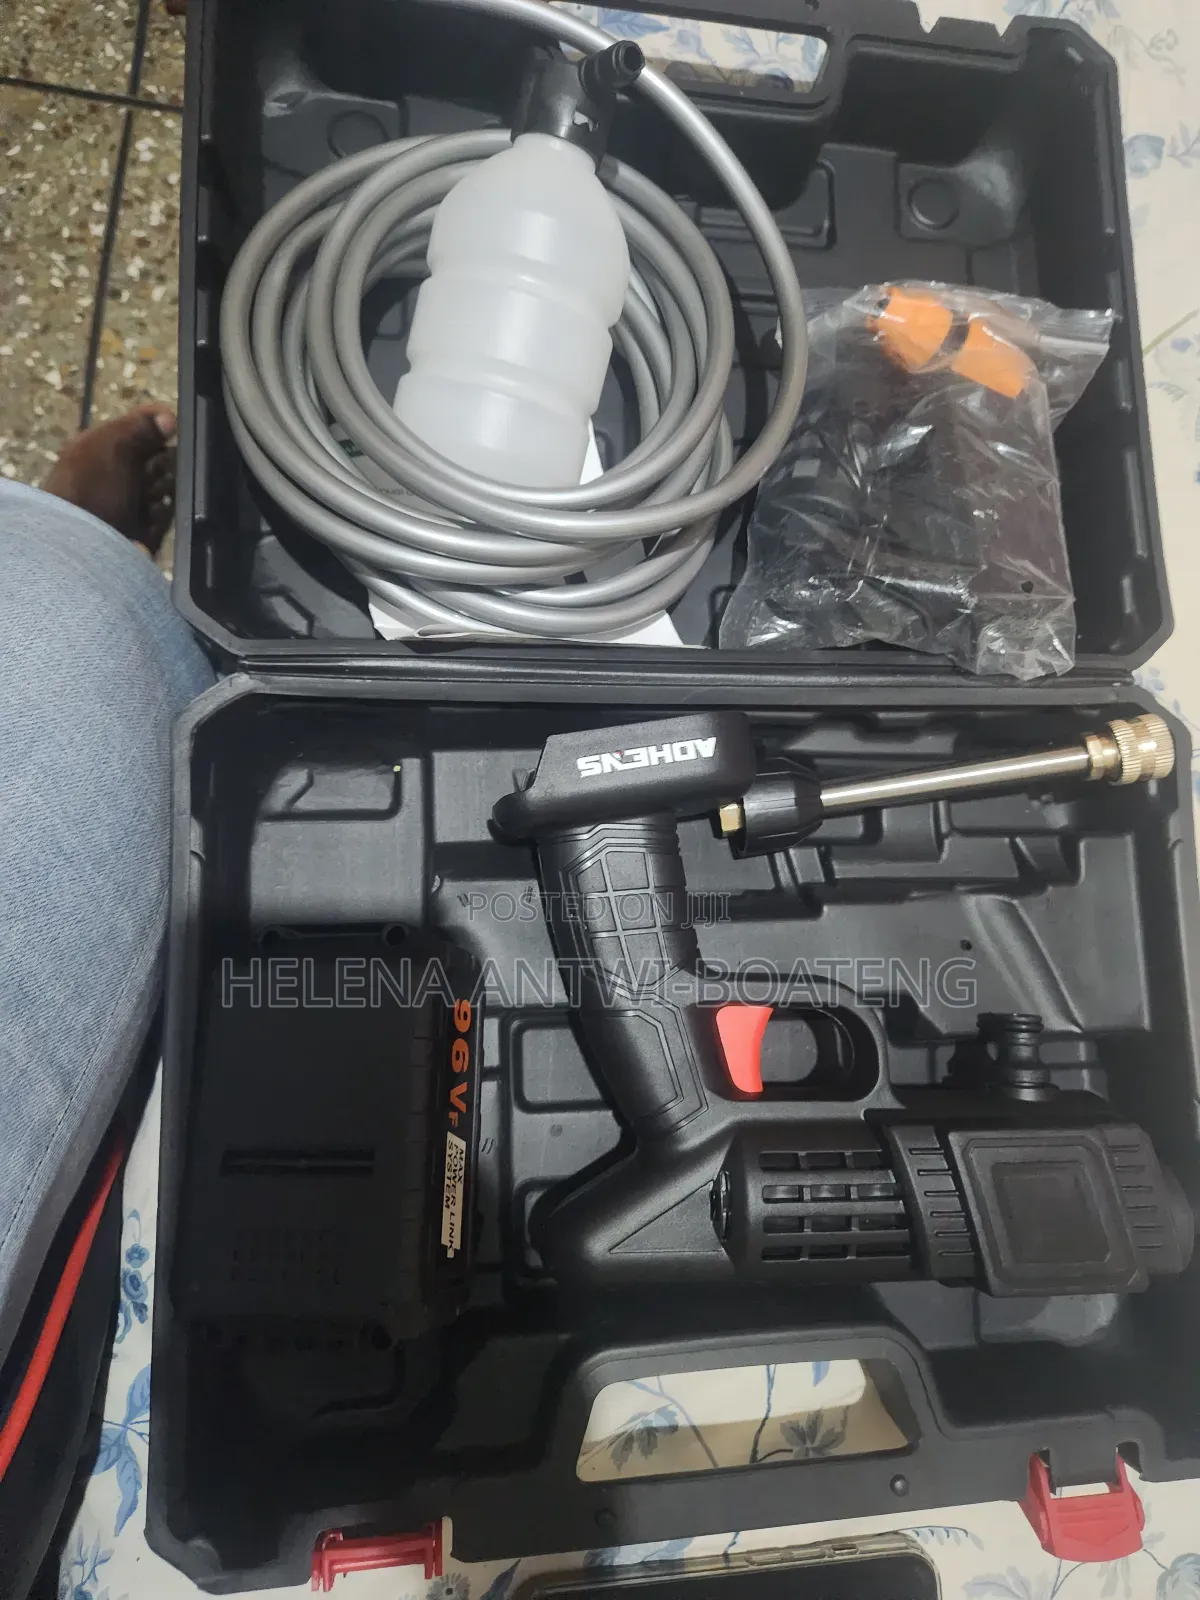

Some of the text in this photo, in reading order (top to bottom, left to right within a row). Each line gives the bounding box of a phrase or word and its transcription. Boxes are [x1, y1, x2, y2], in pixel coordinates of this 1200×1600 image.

[444, 1139, 453, 1209] SYSTEM
[448, 1143, 459, 1251] POWER LINK
